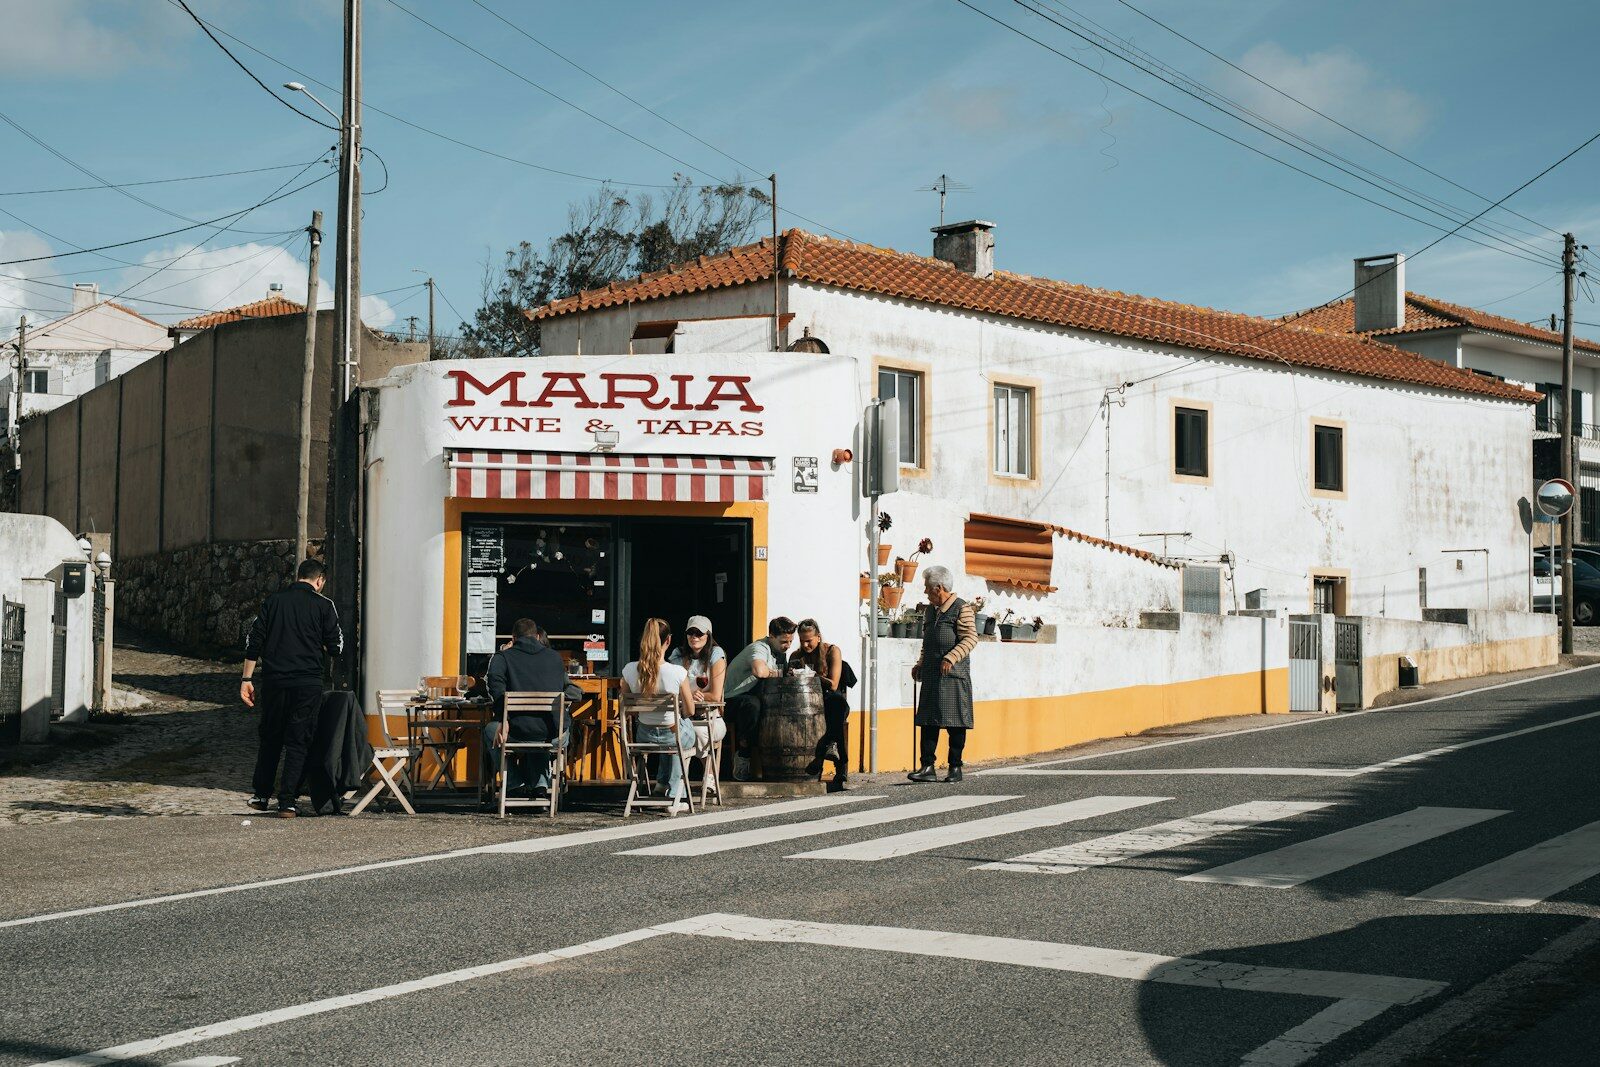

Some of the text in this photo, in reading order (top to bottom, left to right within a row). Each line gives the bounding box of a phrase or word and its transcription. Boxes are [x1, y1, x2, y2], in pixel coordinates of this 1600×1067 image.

[447, 370, 764, 412] MARIA
[449, 416, 764, 437] WINE & TAPAS
